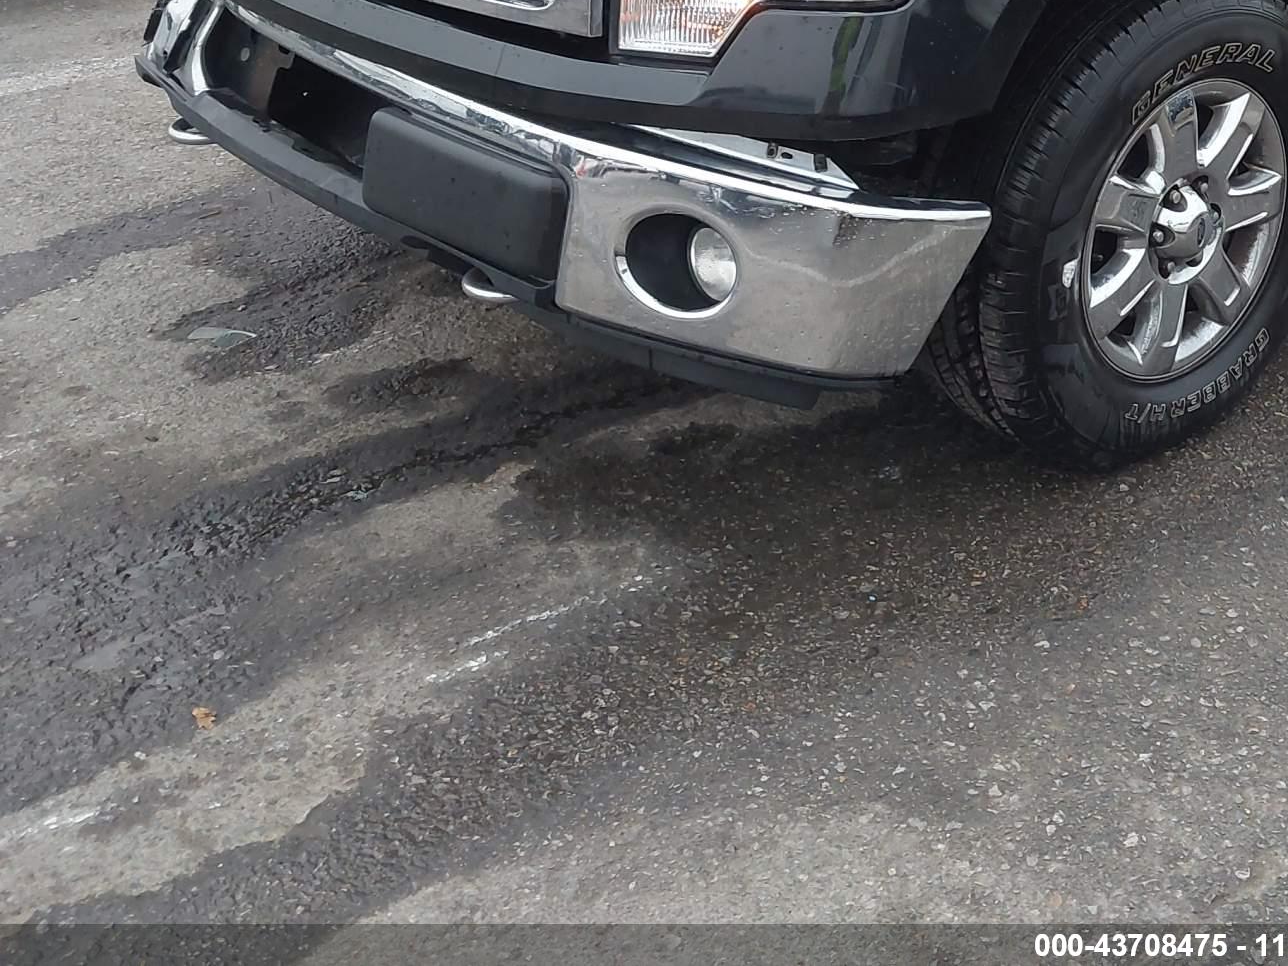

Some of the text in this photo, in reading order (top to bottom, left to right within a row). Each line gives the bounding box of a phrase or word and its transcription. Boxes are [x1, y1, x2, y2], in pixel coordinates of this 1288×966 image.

[1132, 42, 1275, 126] GENERAL
[1124, 328, 1270, 424] GRABBER H/T
